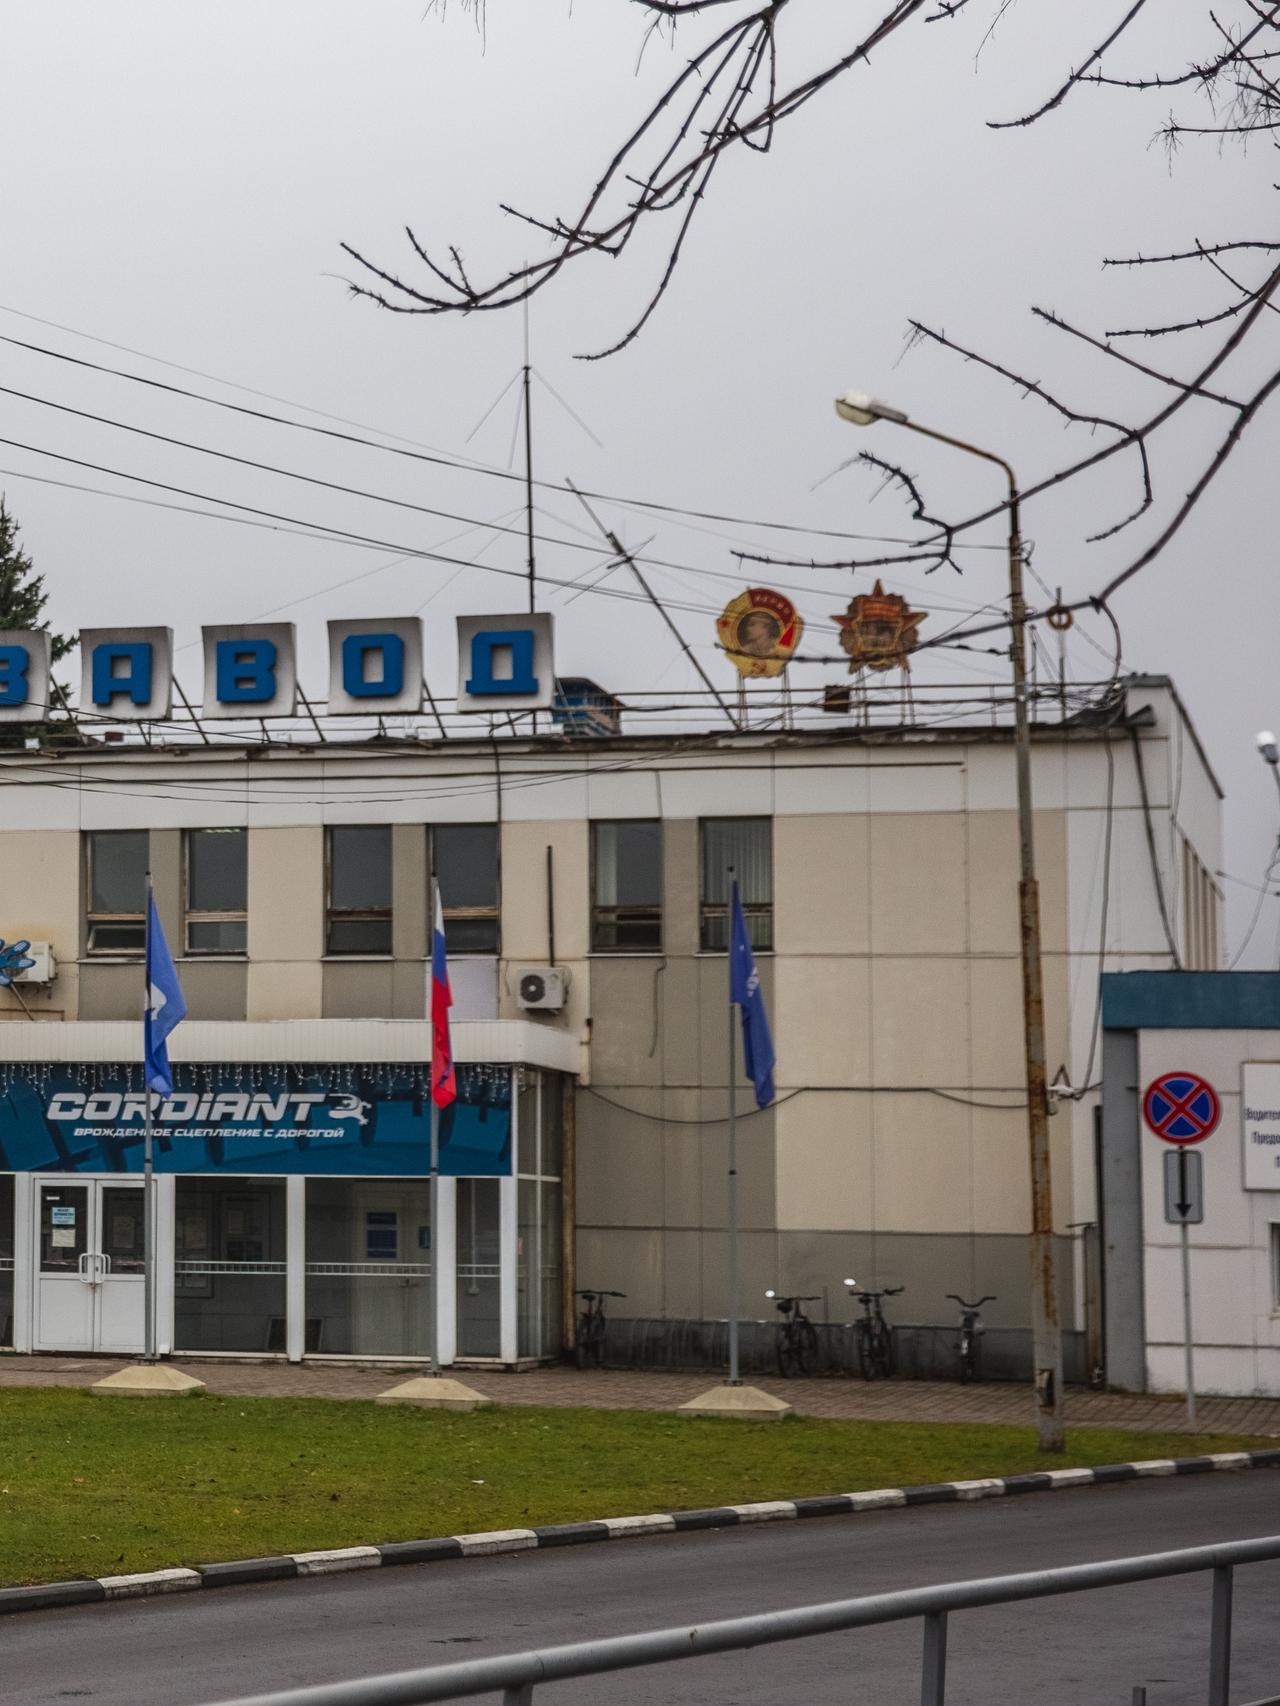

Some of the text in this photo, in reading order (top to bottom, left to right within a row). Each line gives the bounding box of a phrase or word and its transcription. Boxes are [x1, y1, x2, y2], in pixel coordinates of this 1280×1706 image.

[47, 1093, 325, 1121] CORDIANT
[174, 1128, 261, 1138] СЦЕПЛЕНИЕ
[264, 1128, 274, 1137] С
[275, 1127, 345, 1139] ДОРОГОЙ
